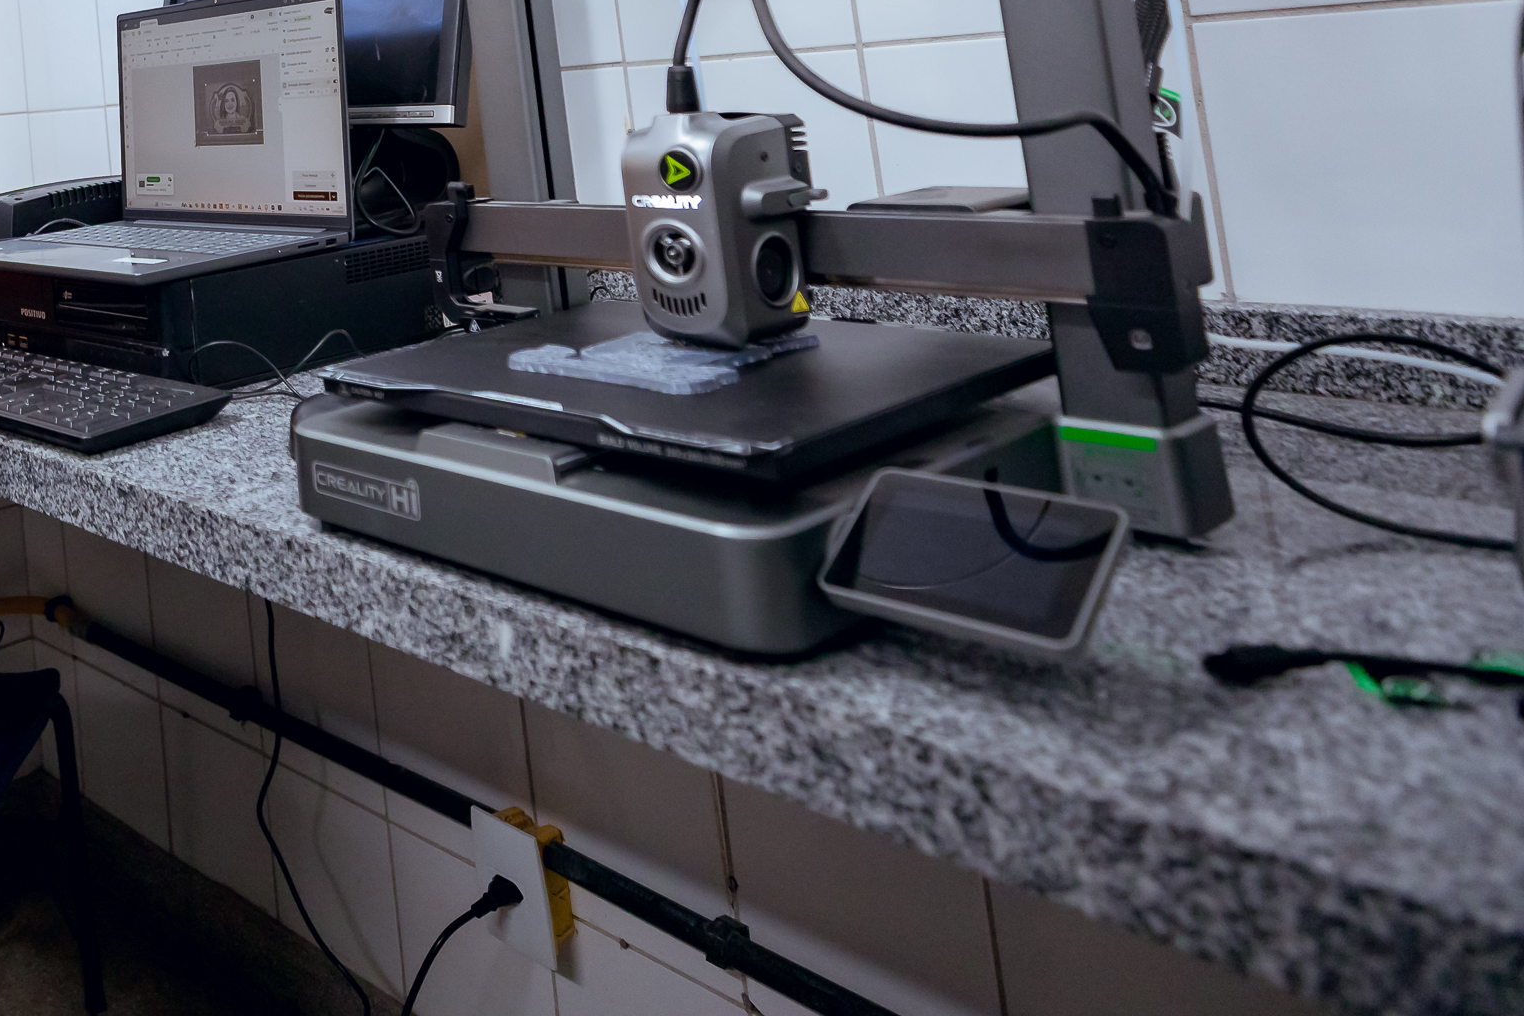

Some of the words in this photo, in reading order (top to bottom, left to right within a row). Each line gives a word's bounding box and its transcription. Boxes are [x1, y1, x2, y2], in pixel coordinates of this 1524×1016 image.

[20, 307, 46, 320] POSITIVO
[317, 470, 386, 502] CREALITY
[390, 477, 419, 516] Hi
